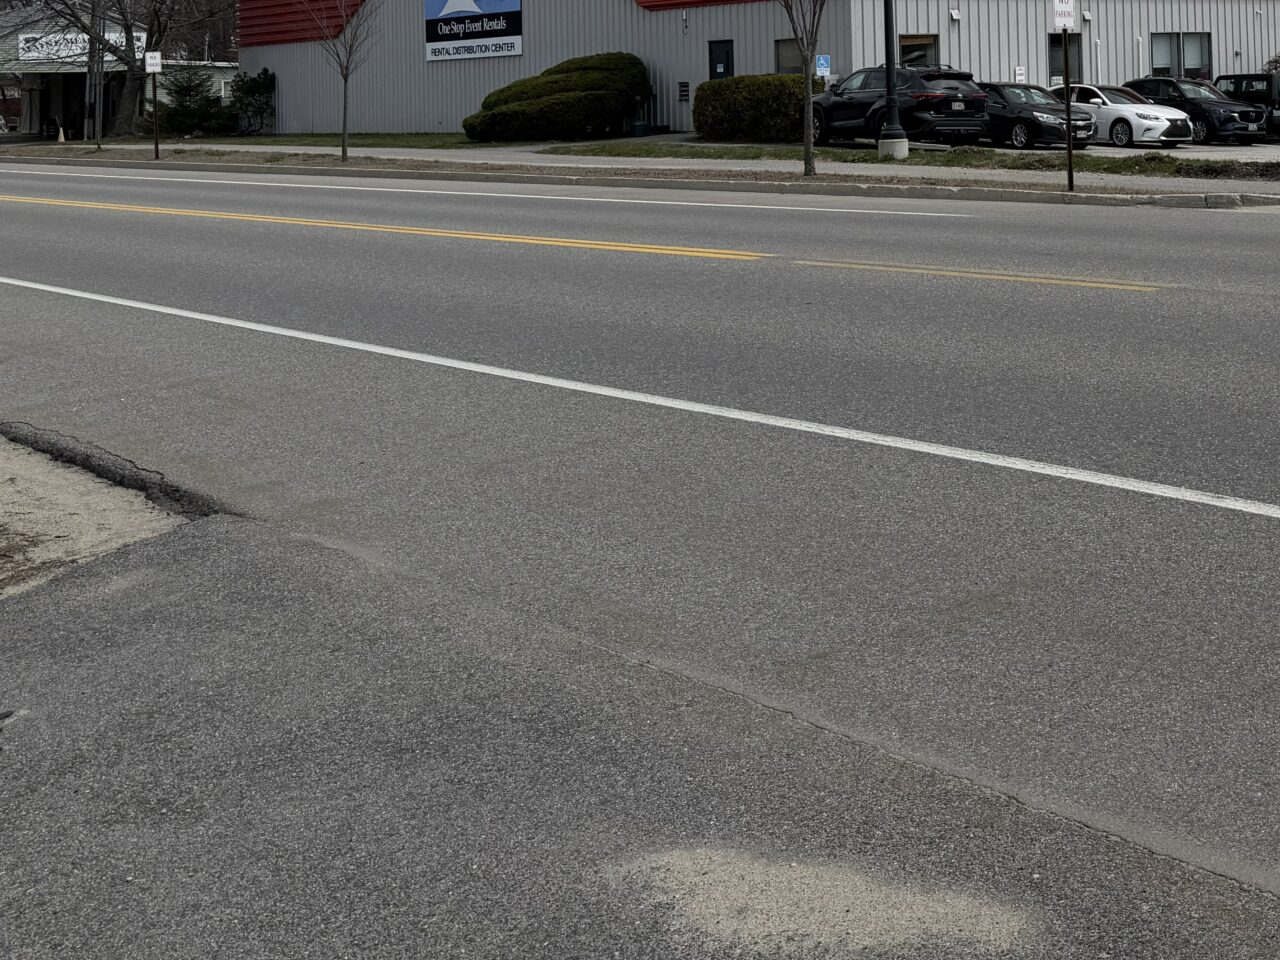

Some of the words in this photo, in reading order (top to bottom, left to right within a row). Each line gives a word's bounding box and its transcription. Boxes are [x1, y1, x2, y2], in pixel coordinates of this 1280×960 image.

[438, 22, 450, 35] One
[450, 21, 465, 37] Stop
[465, 19, 482, 33] Event
[483, 16, 507, 31] Rentals
[431, 47, 452, 57] RENTAL
[452, 44, 490, 55] DISTRIBUTION
[490, 42, 515, 53] CENTER
